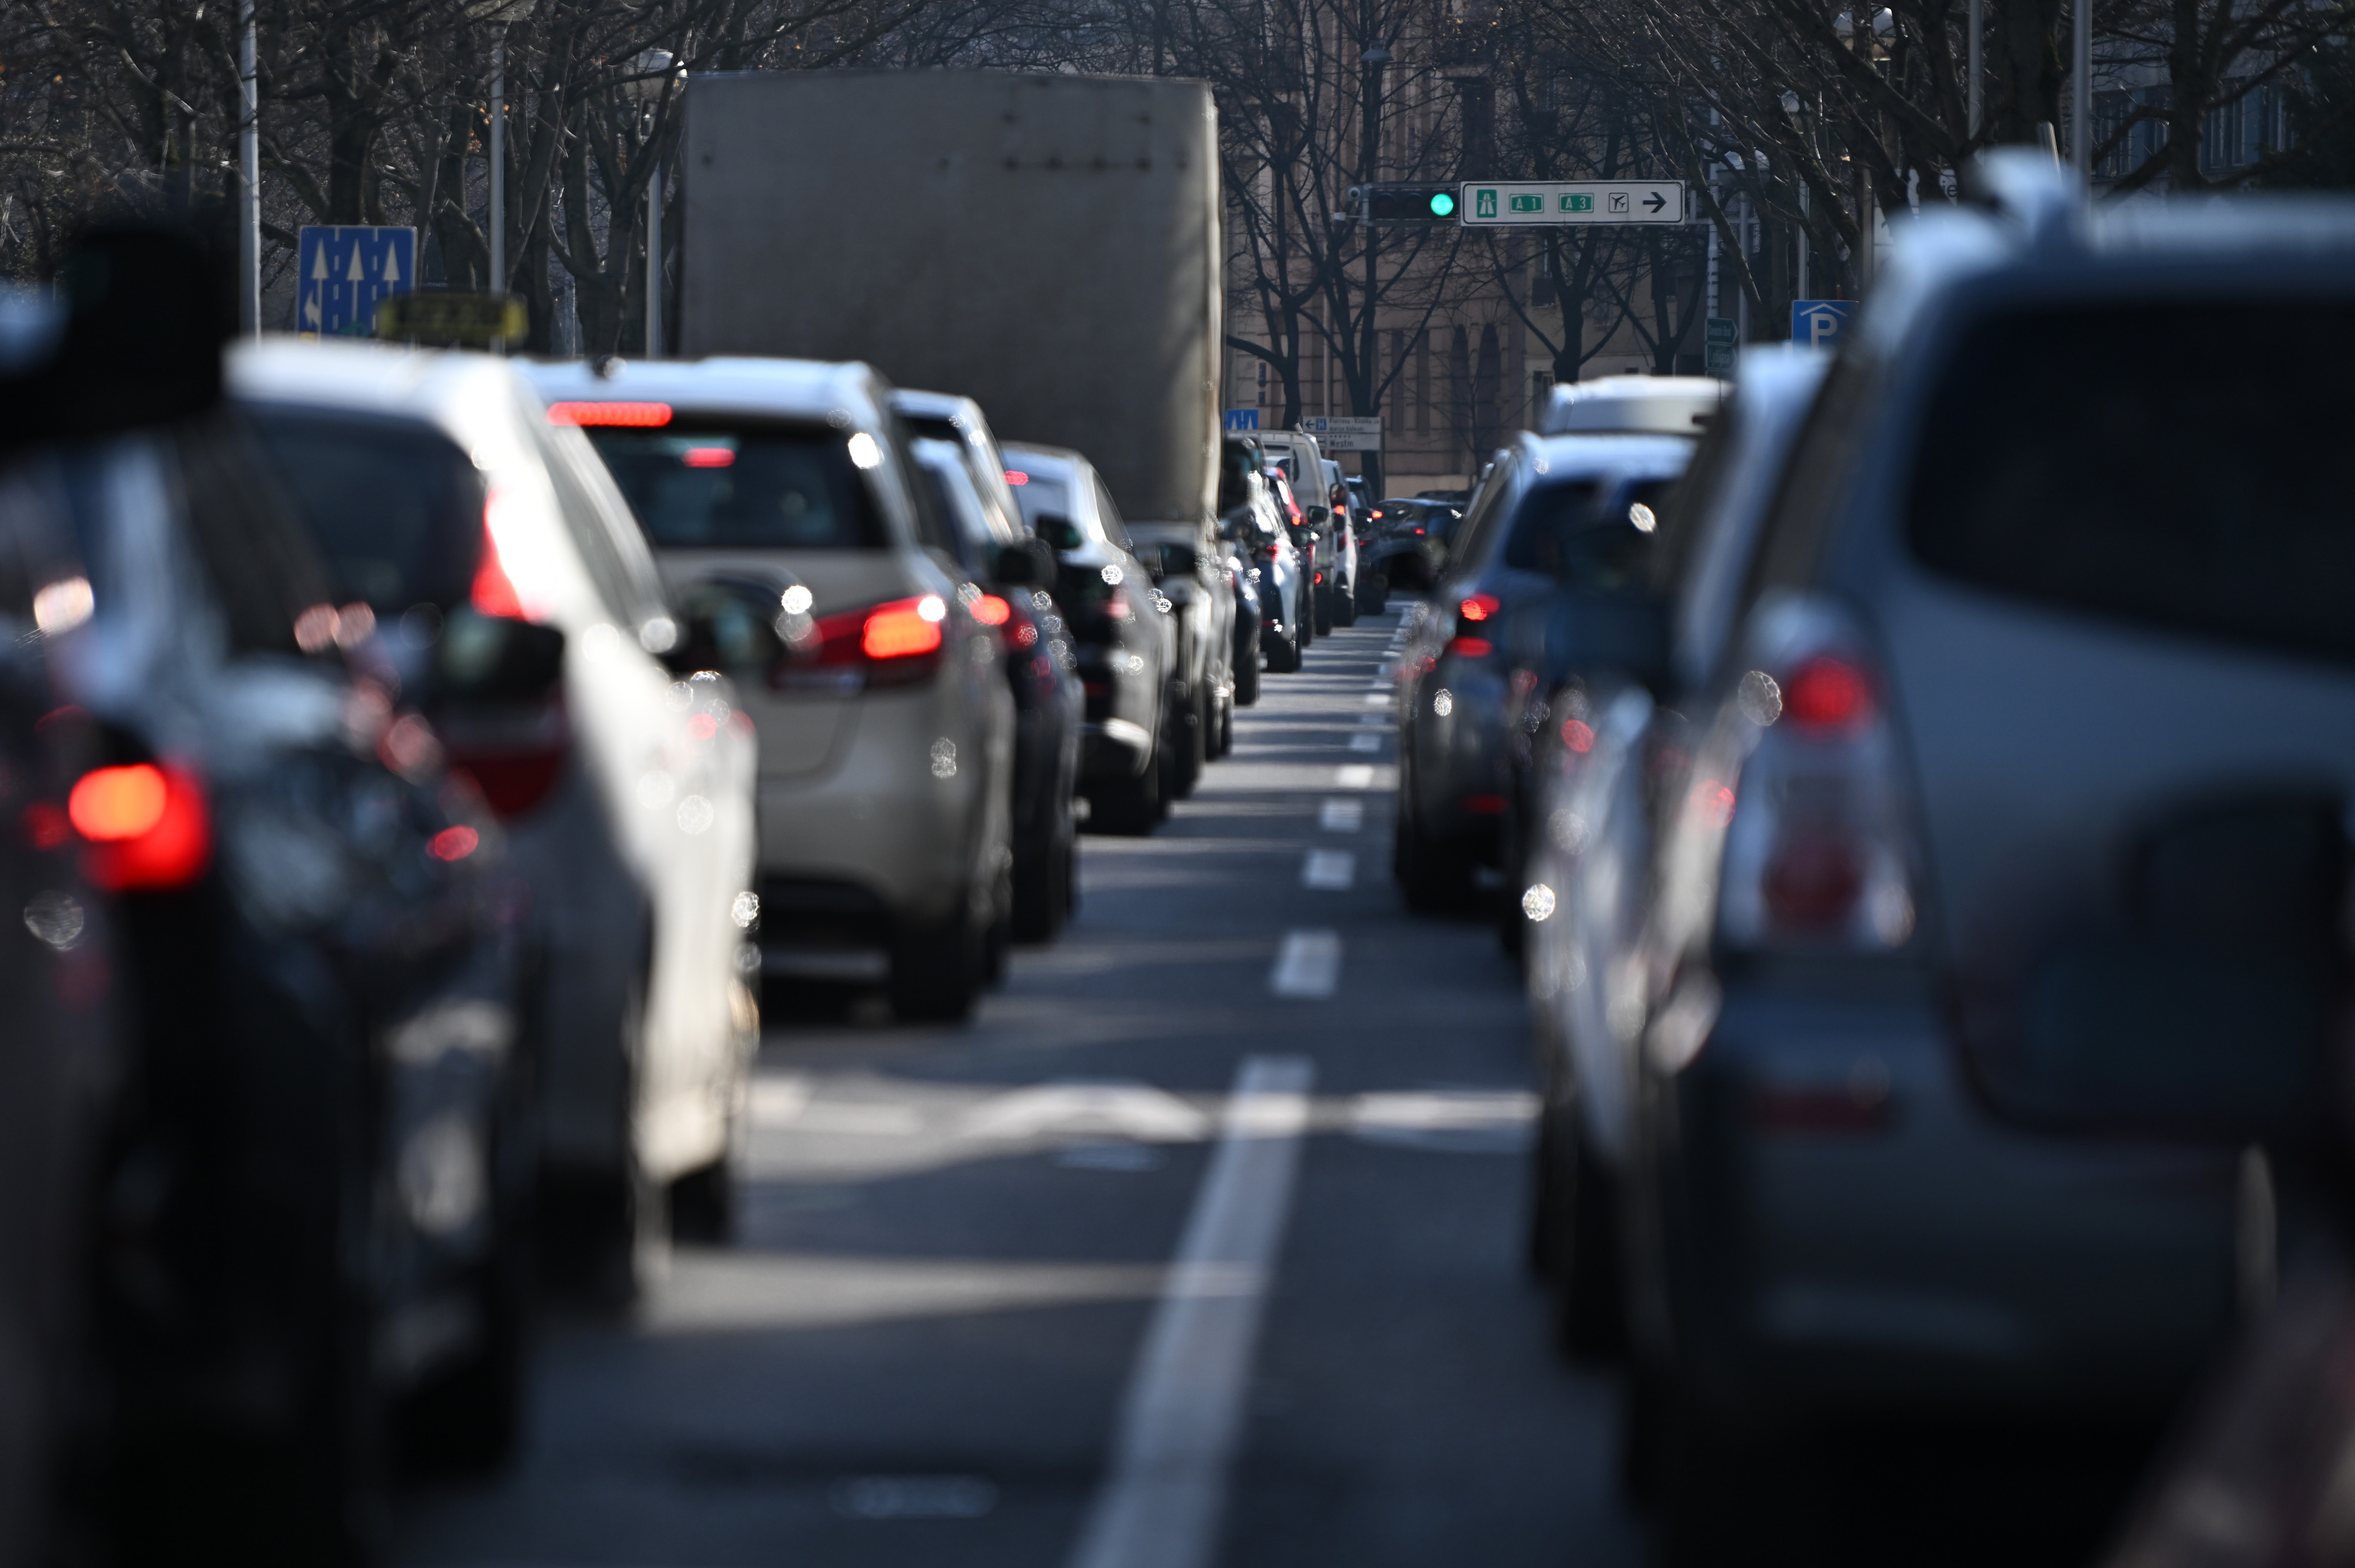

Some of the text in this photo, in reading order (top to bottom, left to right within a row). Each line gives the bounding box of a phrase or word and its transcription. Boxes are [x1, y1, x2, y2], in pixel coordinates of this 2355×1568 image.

[1516, 197, 1536, 210] A 1
[1565, 197, 1586, 209] A 3
[1810, 313, 1838, 352] P
